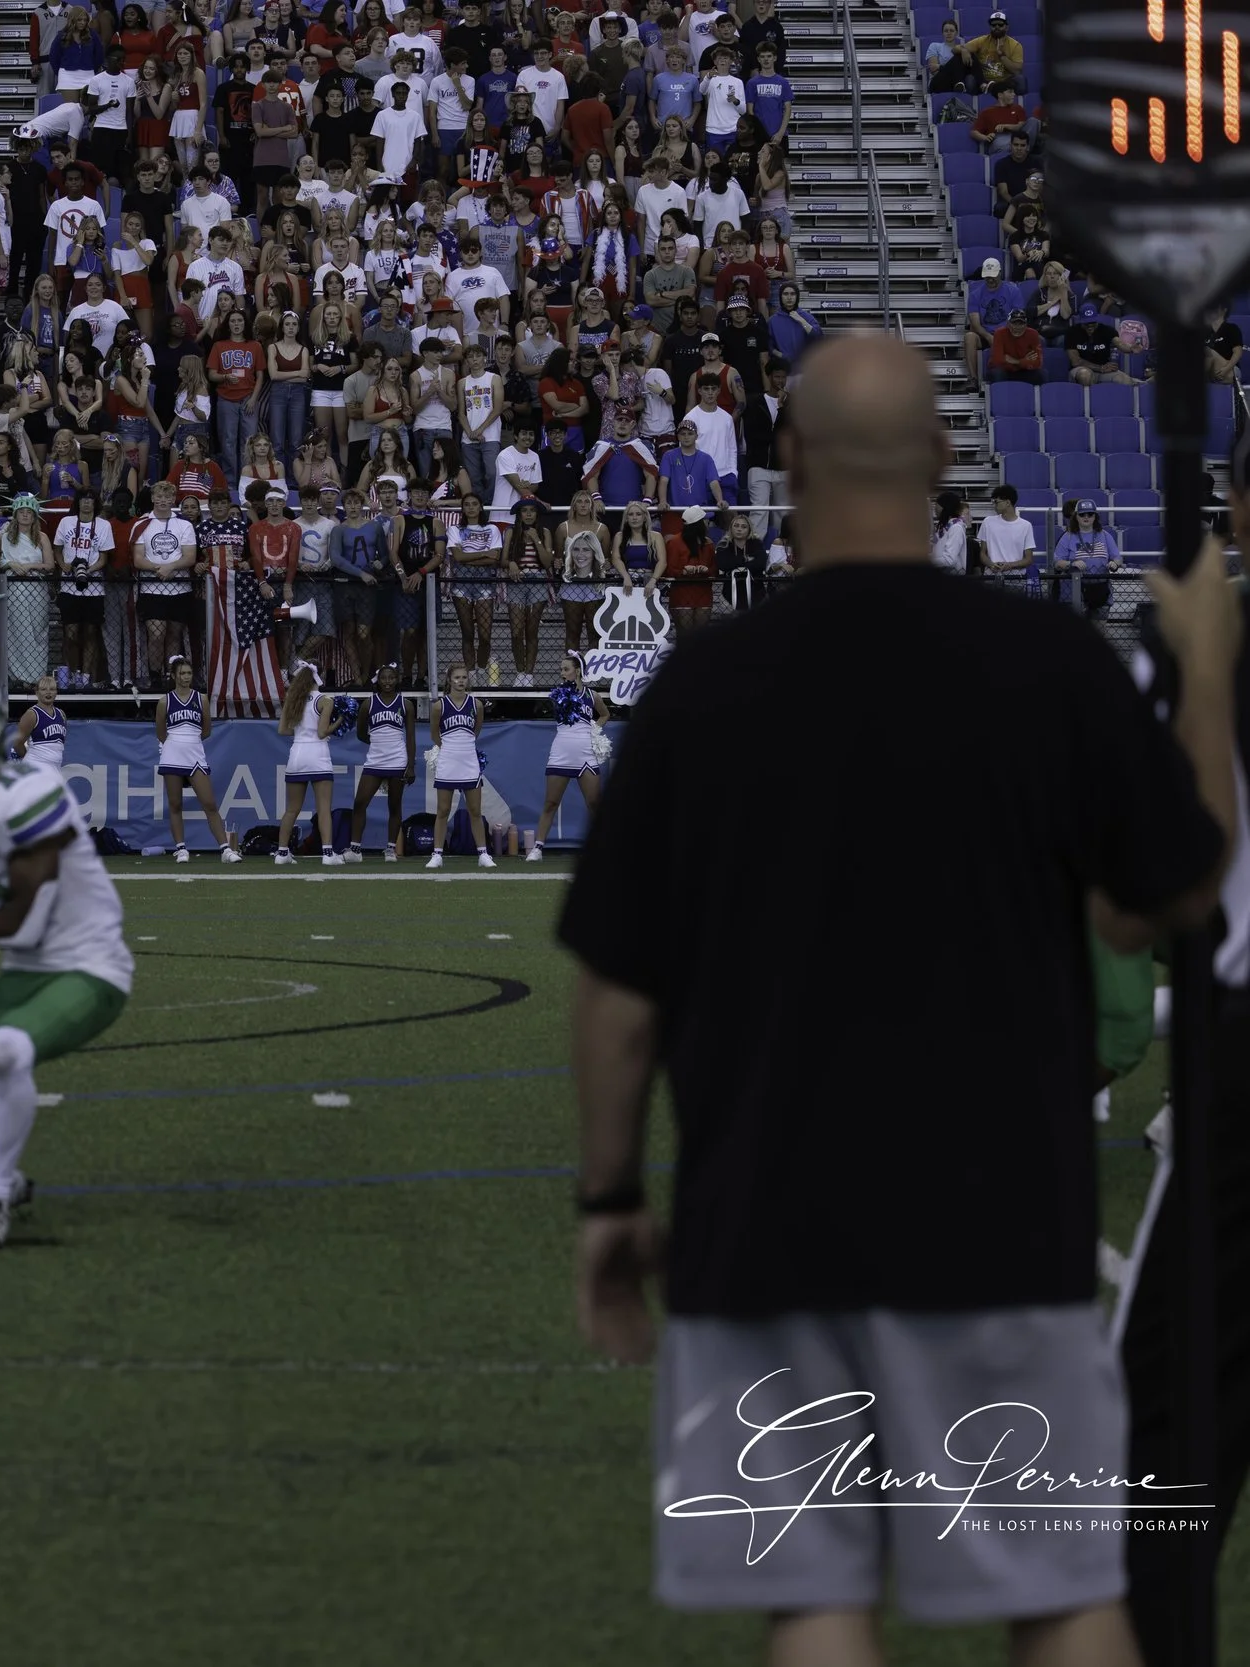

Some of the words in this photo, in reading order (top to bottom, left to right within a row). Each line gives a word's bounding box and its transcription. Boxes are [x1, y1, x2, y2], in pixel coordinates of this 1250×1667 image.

[674, 92, 680, 101] 3
[221, 349, 254, 370] USA
[70, 537, 91, 550] RED
[263, 535, 288, 561] U
[301, 530, 322, 564] S
[351, 535, 370, 565] A
[585, 643, 672, 676] HORNS
[616, 674, 652, 700] UP
[169, 709, 202, 724] VIKINGS
[371, 710, 404, 726] VIKINGS
[443, 714, 475, 729] VIKINGS
[42, 723, 67, 739] VIKING
